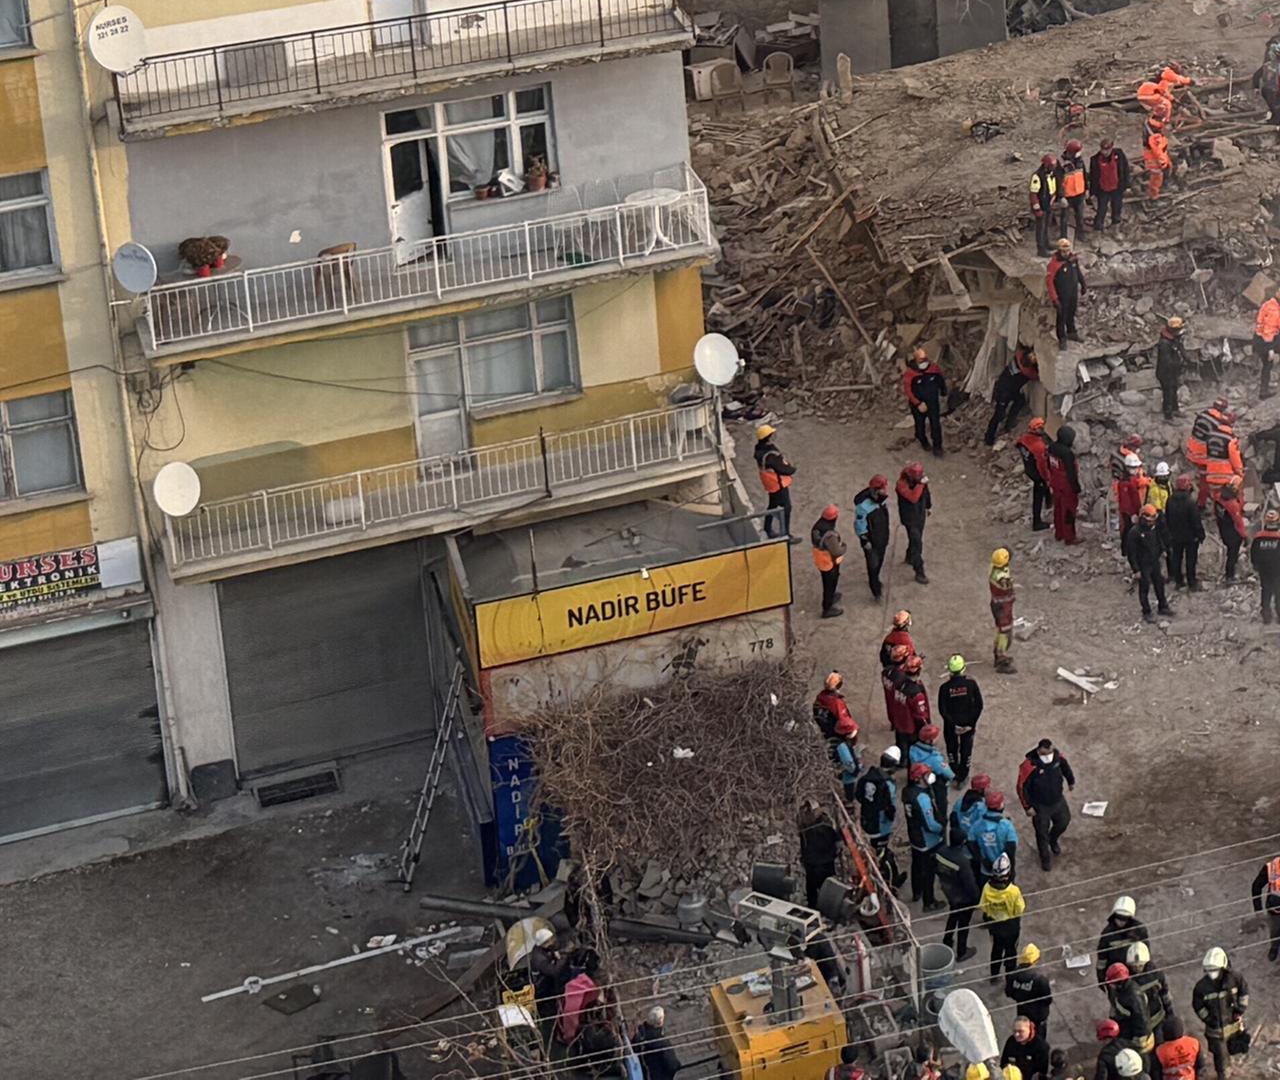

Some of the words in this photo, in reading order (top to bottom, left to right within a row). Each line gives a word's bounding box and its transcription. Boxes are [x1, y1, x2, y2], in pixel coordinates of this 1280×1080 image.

[567, 593, 640, 628] NADİR
[645, 580, 707, 612] BÜFE
[749, 637, 775, 653] 778
